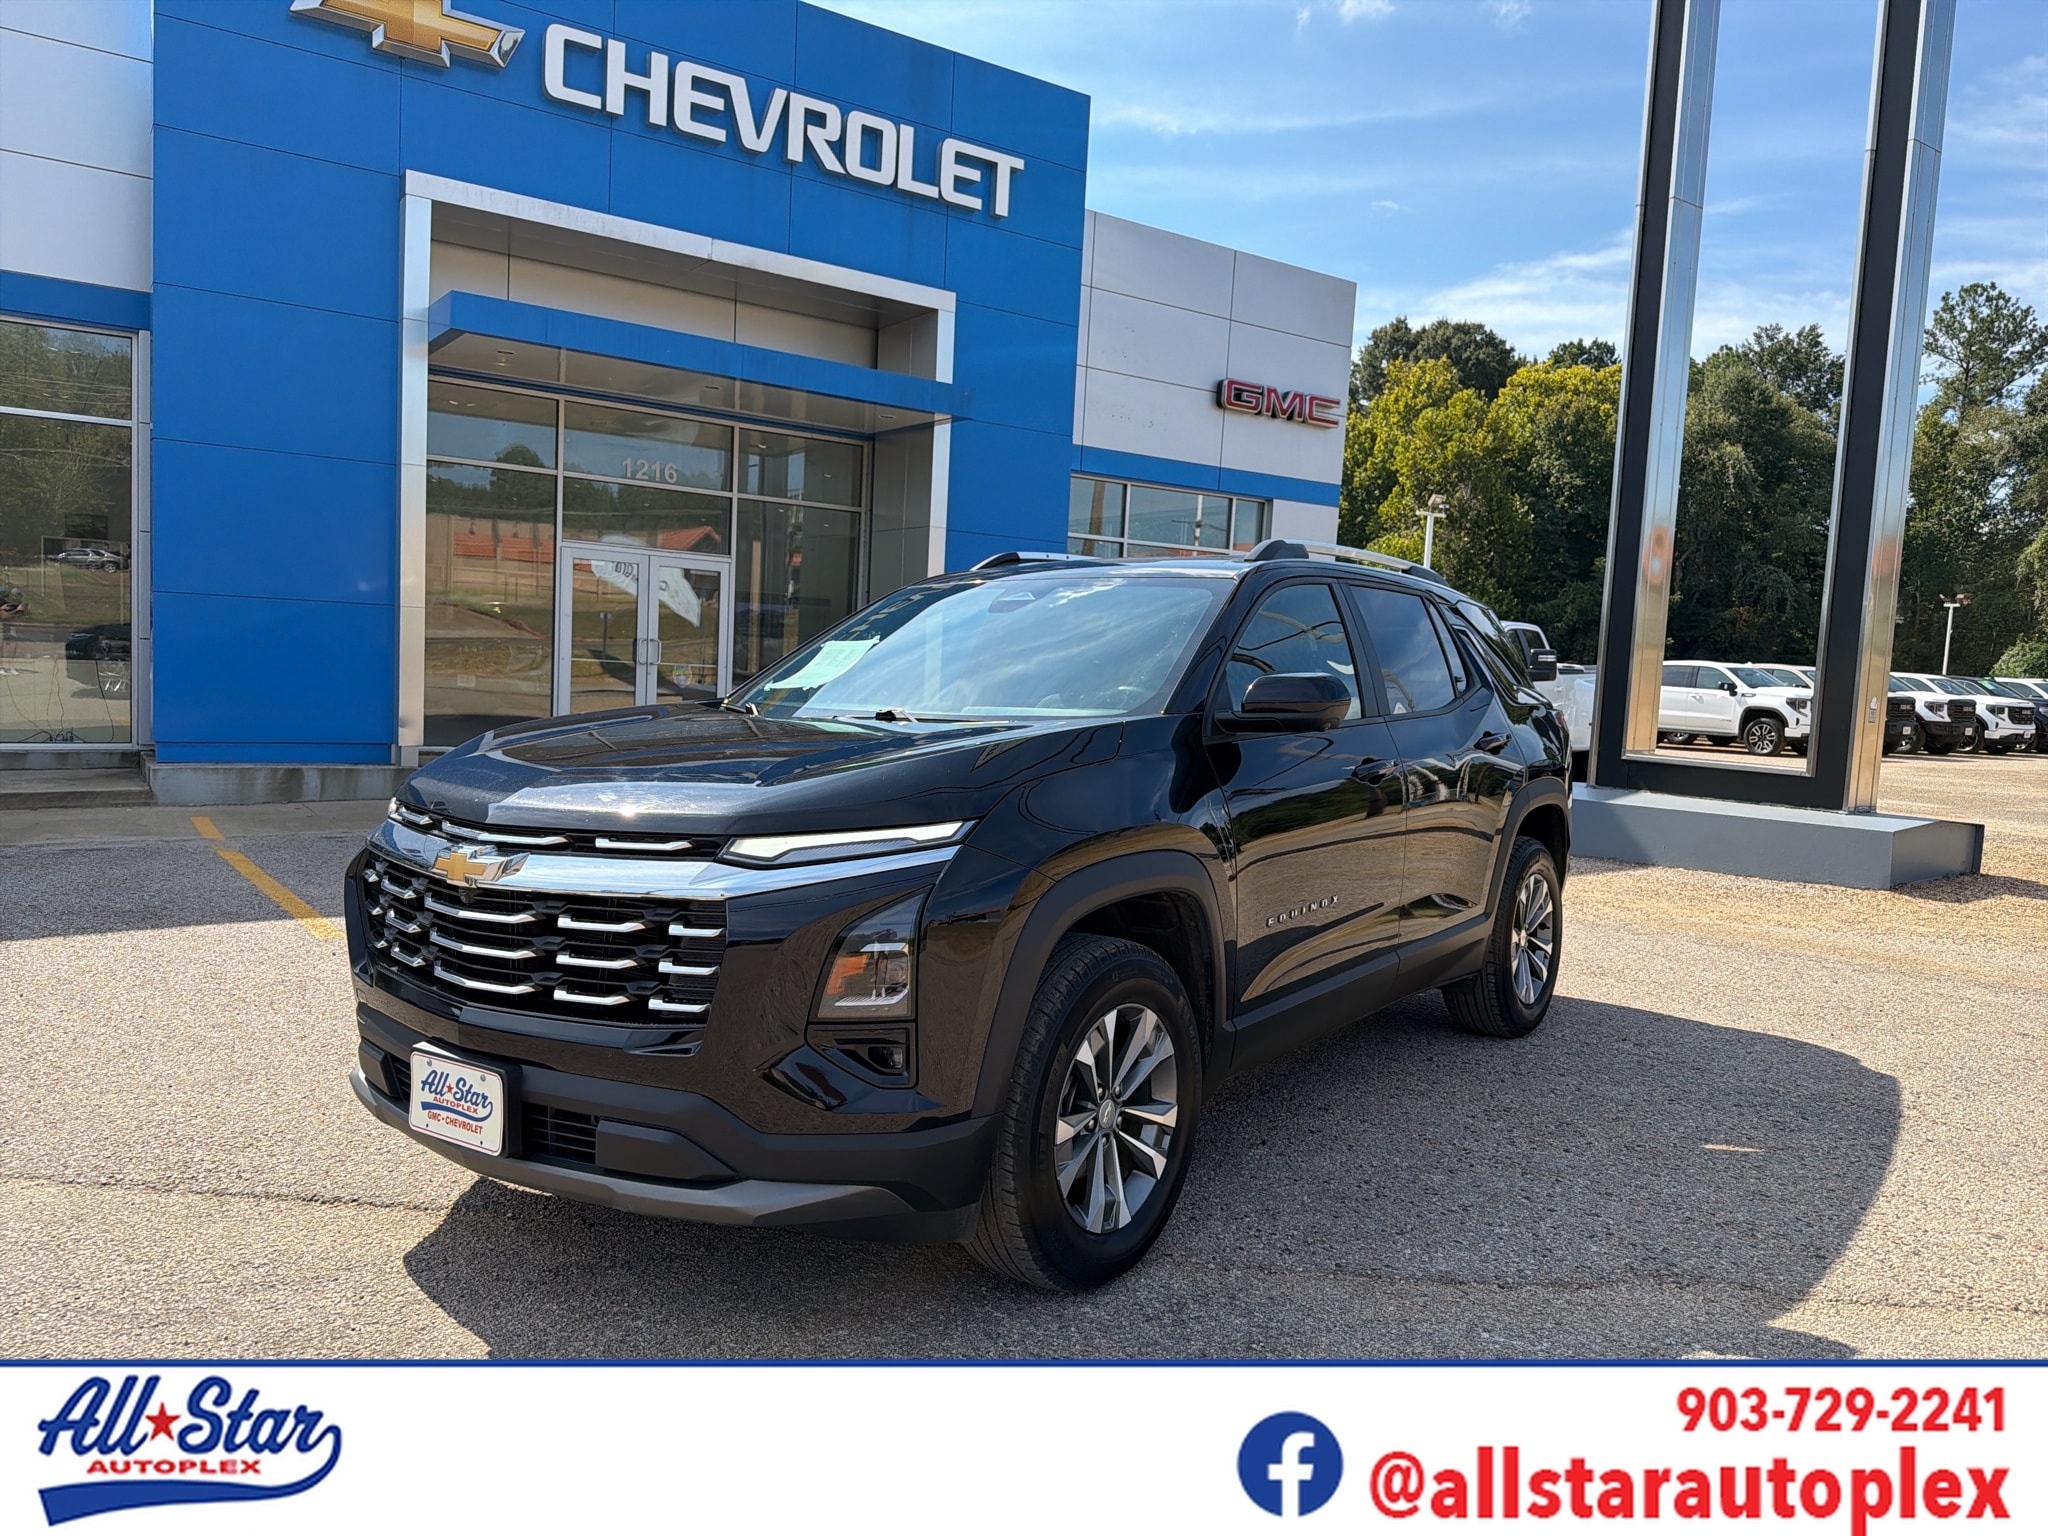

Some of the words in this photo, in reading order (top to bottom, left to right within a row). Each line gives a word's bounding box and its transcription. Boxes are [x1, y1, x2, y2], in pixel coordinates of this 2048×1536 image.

[543, 23, 1025, 218] CHEVROLET
[1217, 378, 1340, 428] GMC
[622, 456, 677, 484] 1216
[1266, 895, 1338, 928] EQUINOX
[421, 1069, 449, 1097] All
[453, 1076, 493, 1109] Star
[432, 1096, 479, 1114] AUTOPLEX
[427, 1110, 441, 1122] GMC
[445, 1115, 483, 1136] CHEVROLET
